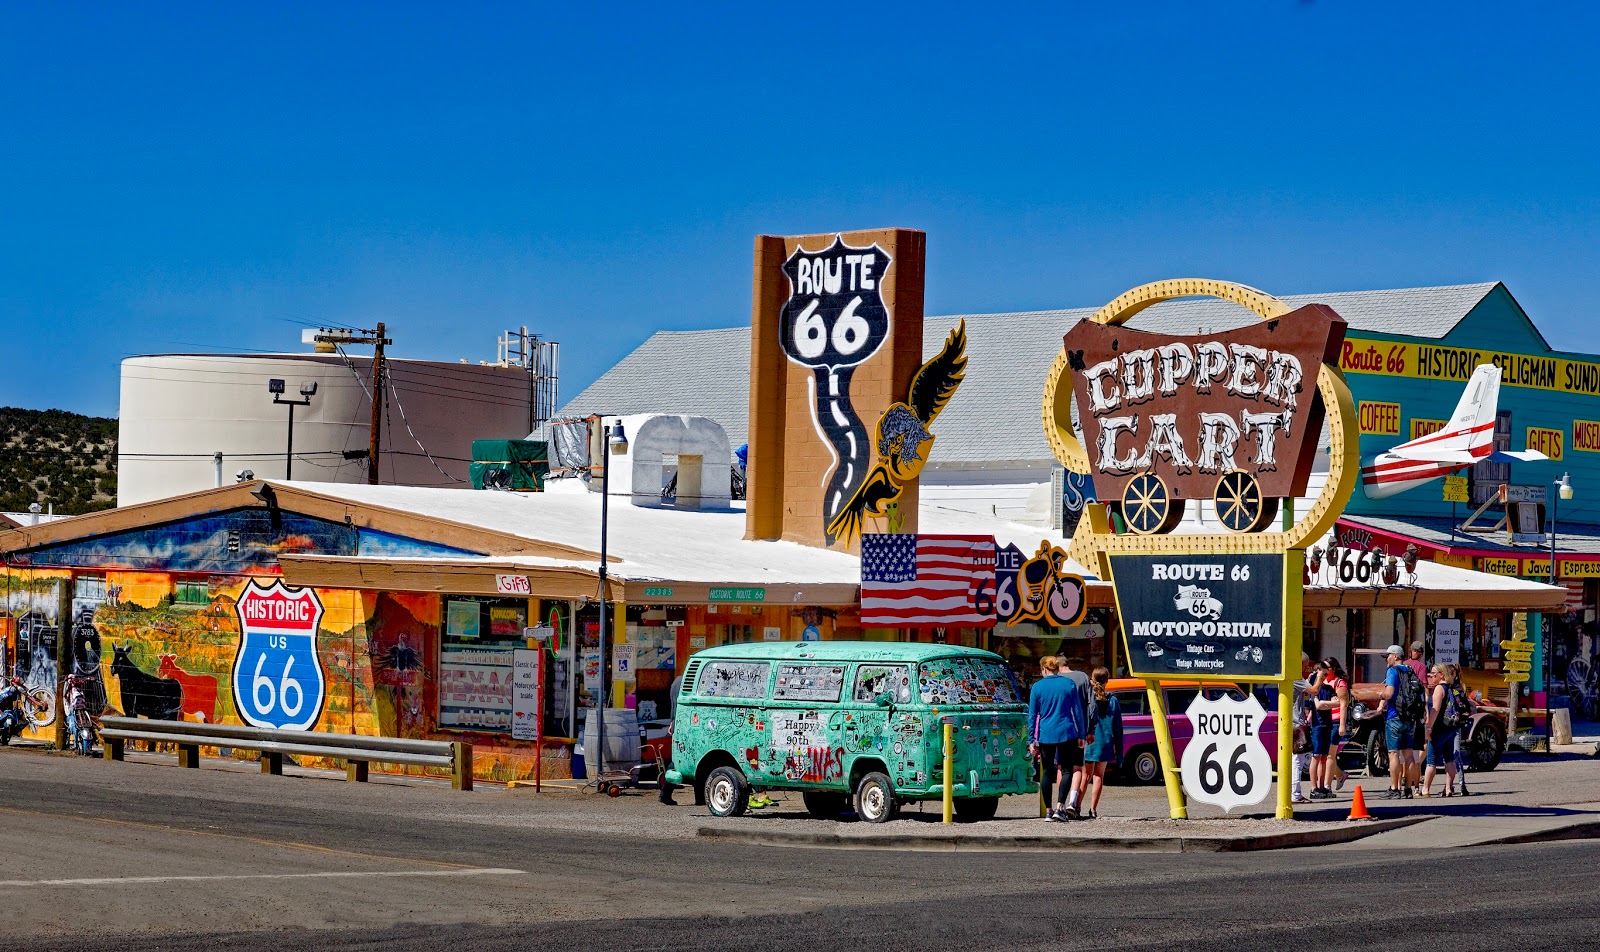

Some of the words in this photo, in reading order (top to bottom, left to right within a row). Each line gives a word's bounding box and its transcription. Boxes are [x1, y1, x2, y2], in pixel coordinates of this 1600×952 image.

[797, 253, 875, 296] ROUTE
[794, 295, 870, 358] 66
[1342, 341, 1383, 371] Route
[1386, 345, 1406, 373] 66
[1418, 346, 1481, 379] HISTORIC
[1565, 363, 1600, 393] SUND
[1083, 341, 1303, 418] COPPER
[1360, 403, 1399, 434] COFFEE
[1095, 408, 1291, 475] CART
[1529, 429, 1561, 458] GIFTS
[1340, 528, 1373, 548] ROUTE
[973, 551, 1019, 568] ROUTE
[1340, 549, 1370, 583] 66
[1485, 561, 1516, 574] Kaffee
[1528, 560, 1551, 574] Java
[1152, 564, 1224, 581] ROUTE
[1230, 565, 1250, 581] 66
[645, 588, 672, 596] 22385
[709, 590, 732, 599] HISTORIC
[735, 590, 751, 599] ROUTE
[754, 591, 764, 599] 66
[975, 575, 1015, 616] 66
[246, 600, 310, 621] HISTORIC
[1192, 599, 1207, 614] 66
[80, 628, 95, 636] 3783
[1132, 621, 1271, 638] MOTOPORIUM
[269, 636, 287, 650] US
[1186, 644, 1203, 655] Vintage
[1203, 644, 1215, 653] Cars
[515, 661, 529, 669] Classic
[1175, 659, 1192, 669] Vintage
[1193, 658, 1224, 669] Motorcycles
[522, 671, 532, 679] and
[255, 653, 304, 716] 66
[520, 692, 534, 700] Inside
[642, 711, 653, 720] 66
[784, 719, 816, 732] Happy
[1198, 713, 1253, 736] ROUTE
[786, 735, 809, 746] 90th
[1198, 742, 1254, 796] 66
